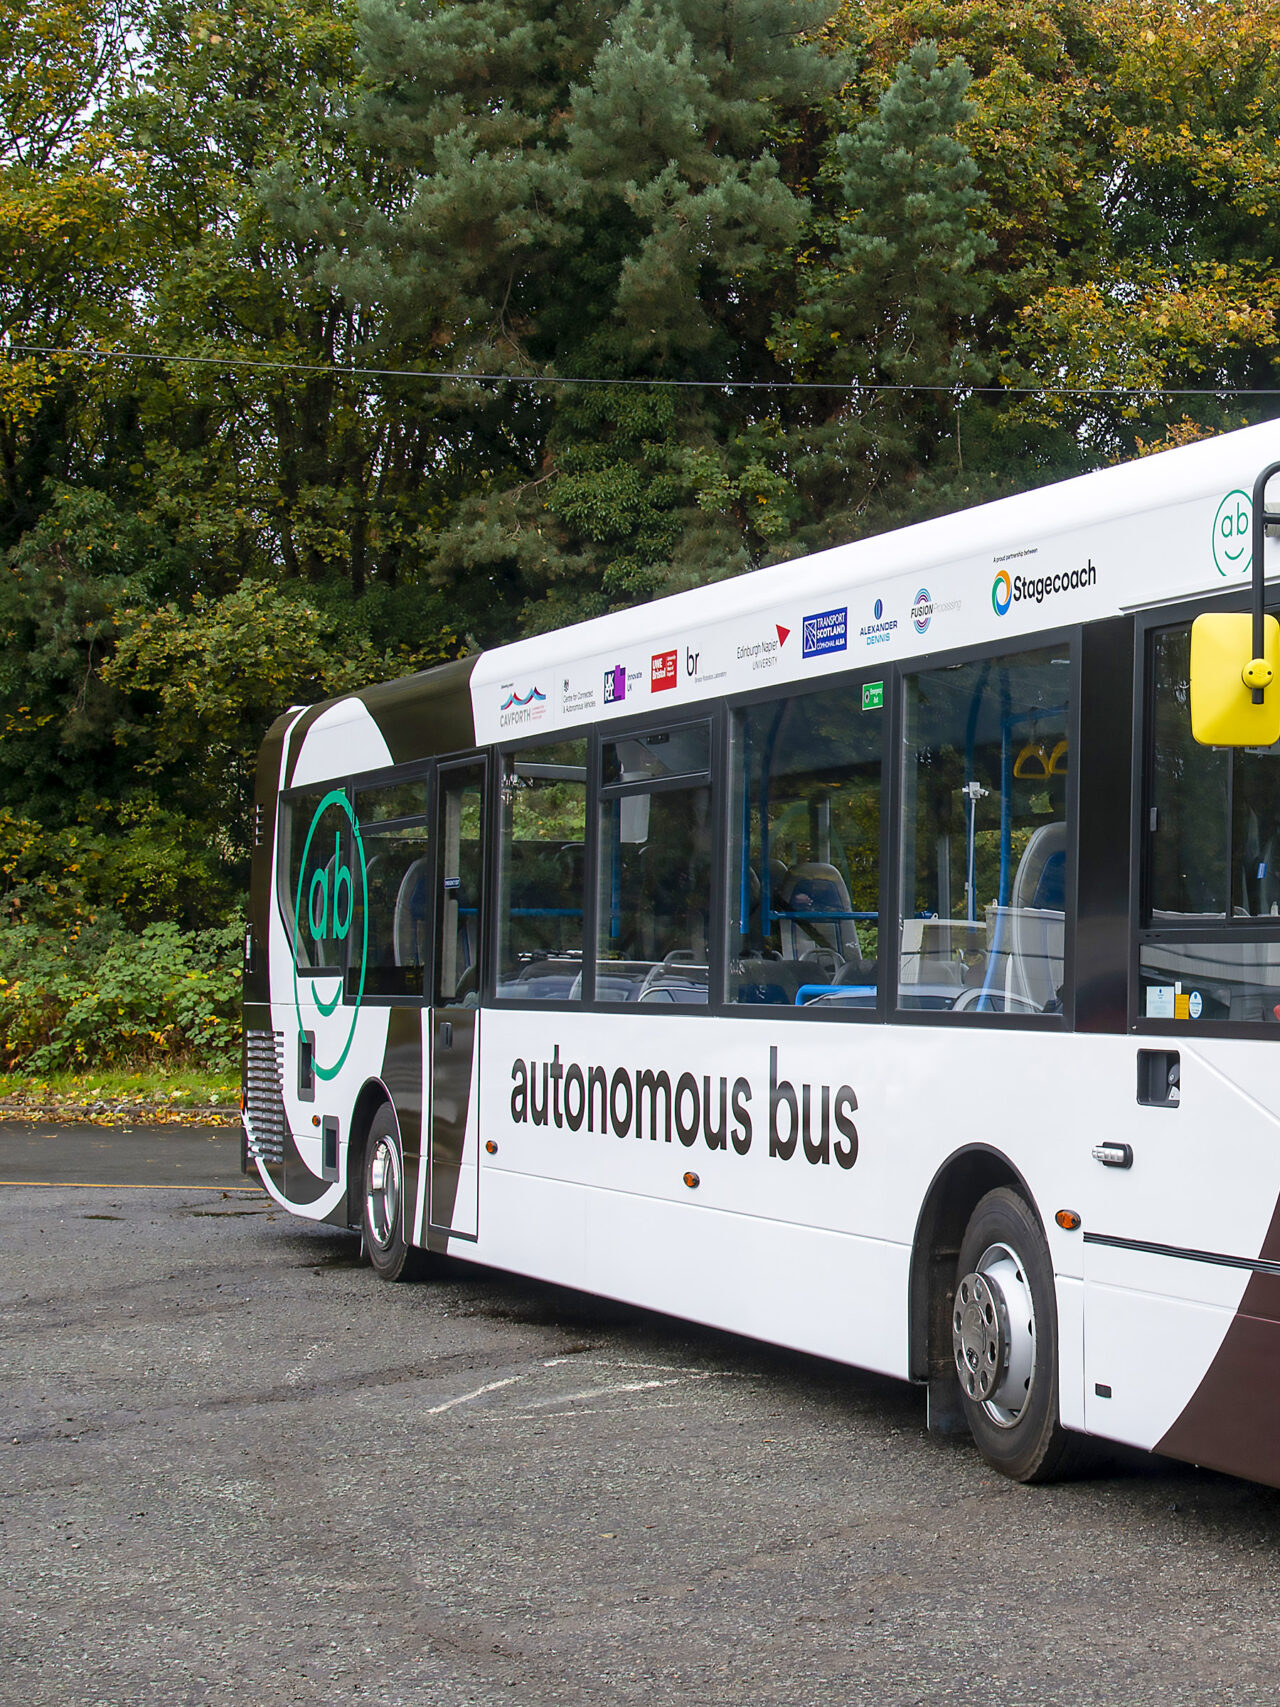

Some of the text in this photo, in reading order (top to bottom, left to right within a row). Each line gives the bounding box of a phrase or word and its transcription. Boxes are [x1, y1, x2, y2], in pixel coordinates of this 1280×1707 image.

[1221, 501, 1249, 538] ab
[1013, 558, 1097, 604] Stagecoach
[910, 604, 934, 619] FUSION
[817, 612, 846, 628] TRANSPORT
[859, 620, 898, 636] ALEXANDER
[817, 624, 846, 639] SCOTLAND
[866, 633, 891, 645] DENNIS
[737, 640, 778, 659] Edinburgh Napier
[652, 657, 663, 670] UWE
[752, 656, 777, 671] UNIVERSITY
[652, 667, 666, 681] Bristol
[500, 708, 531, 728] CAVFORTH
[308, 831, 354, 940] ab
[510, 1044, 859, 1170] autonomous bus
